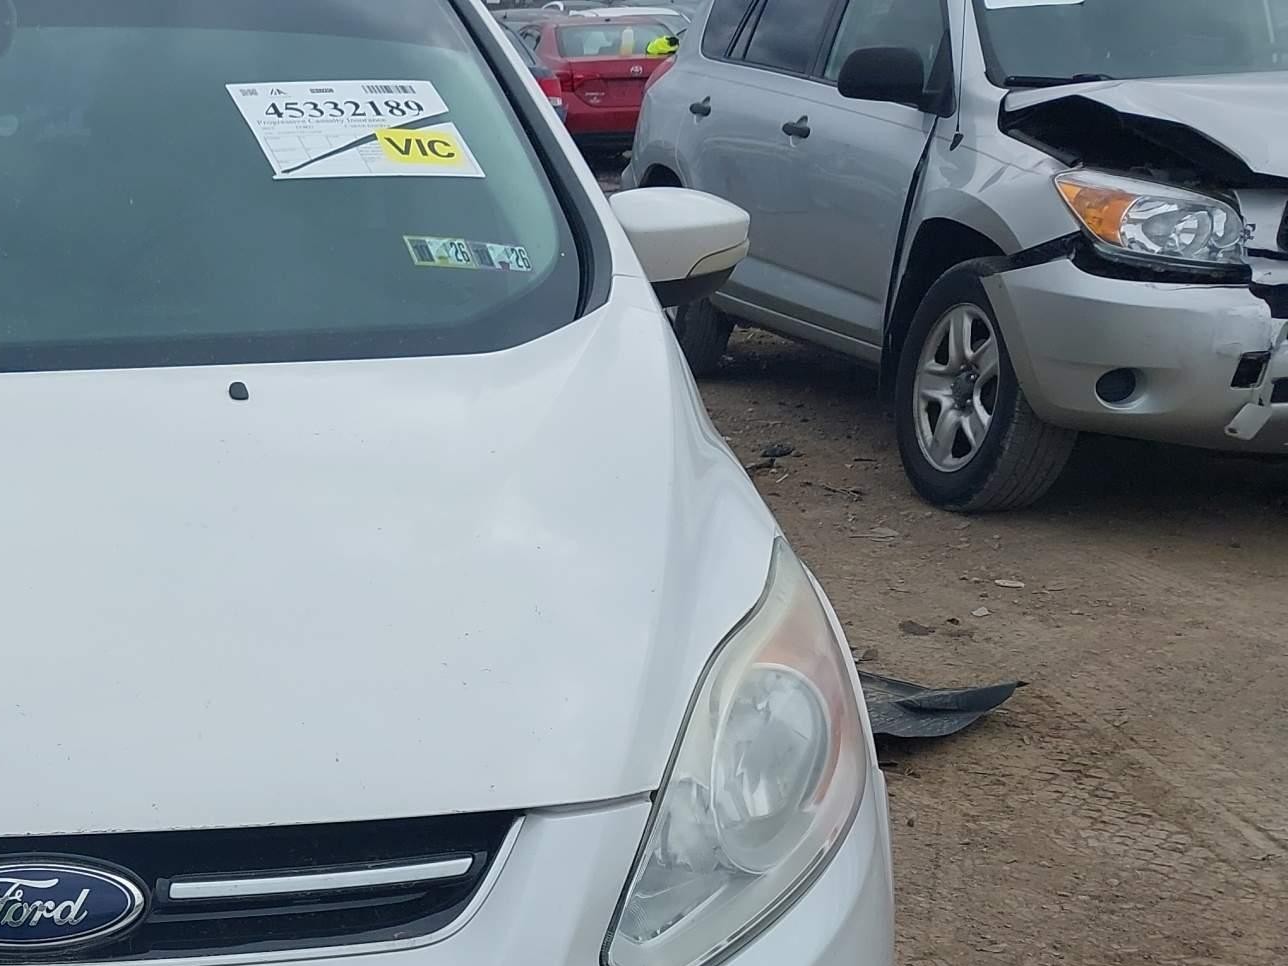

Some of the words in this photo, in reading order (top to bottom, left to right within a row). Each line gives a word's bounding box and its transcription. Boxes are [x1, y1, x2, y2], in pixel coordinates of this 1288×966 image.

[265, 100, 424, 118] 45332189
[383, 136, 455, 158] VIC
[449, 241, 471, 263] 26
[510, 247, 531, 269] 26
